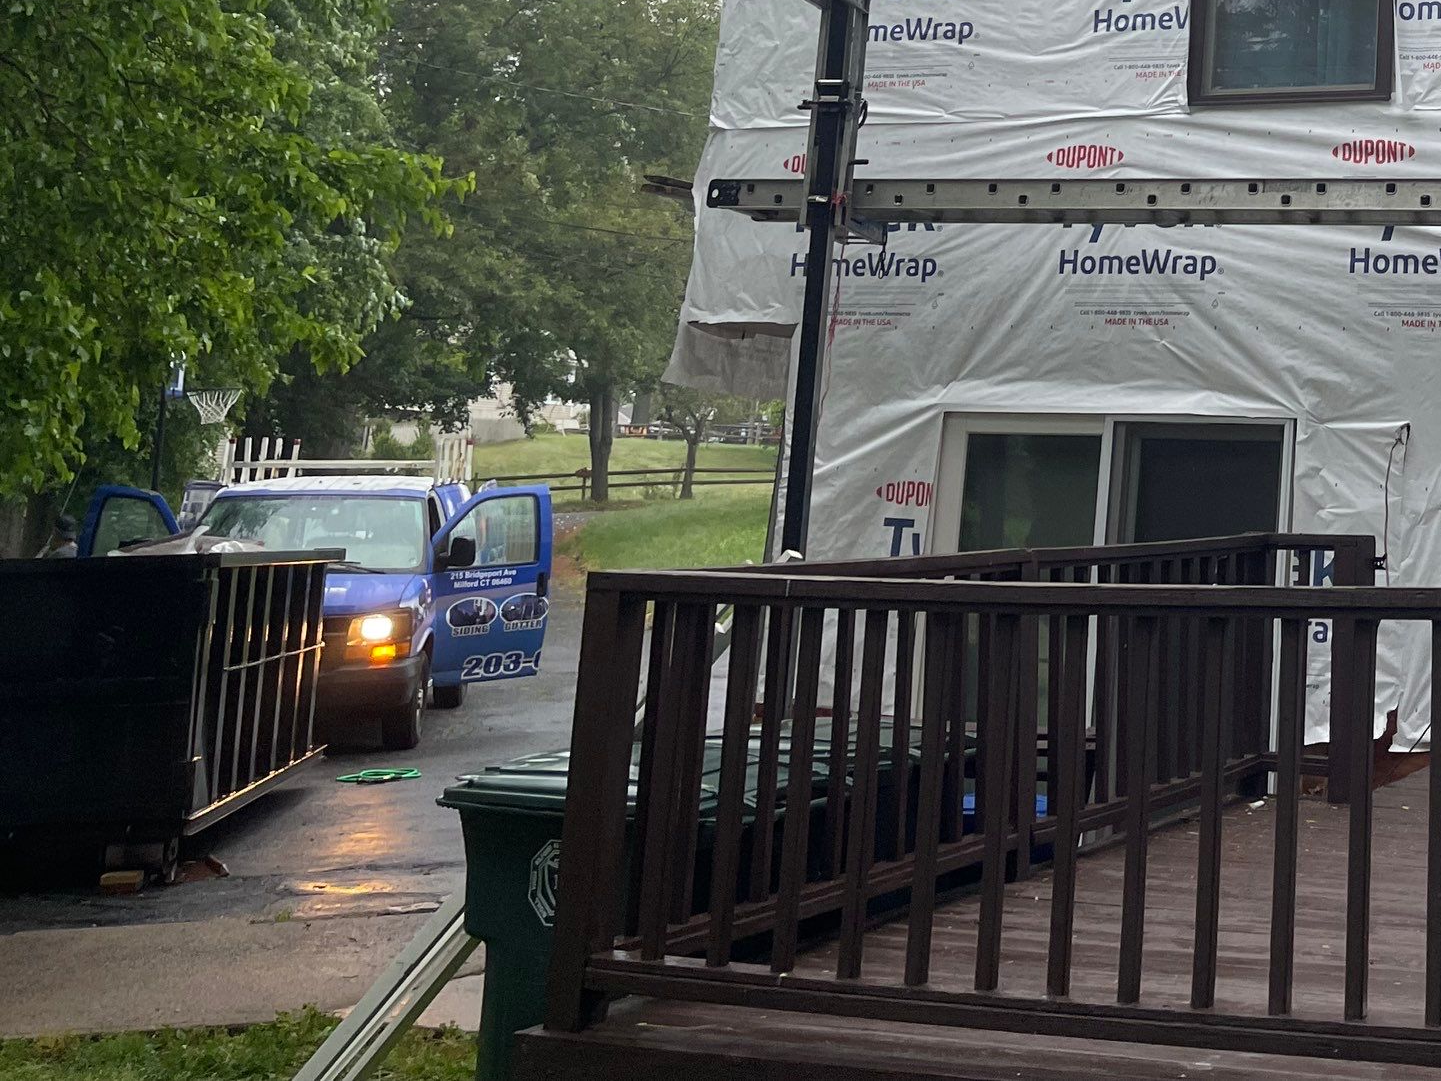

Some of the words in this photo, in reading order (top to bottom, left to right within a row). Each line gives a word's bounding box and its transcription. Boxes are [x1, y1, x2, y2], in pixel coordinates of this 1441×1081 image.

[867, 17, 974, 45] meWrap
[867, 81, 887, 89] MADE
[888, 80, 896, 88] IN
[912, 79, 926, 88] USA
[1056, 145, 1116, 168] DUPONT
[1342, 139, 1406, 164] DUPONT
[790, 252, 938, 283] HmeWrap
[1058, 249, 1218, 281] HomeWrap
[1104, 318, 1127, 326] MADE
[1128, 318, 1137, 326] IN
[1138, 318, 1152, 326] THE
[1153, 318, 1169, 326] USA
[1401, 320, 1426, 328] MADE
[1427, 320, 1437, 328] IN
[886, 481, 933, 507] DUPON
[450, 571, 463, 580] 215
[465, 569, 502, 580] Bridgeport
[503, 569, 517, 577] Ave
[452, 624, 490, 637] SIDING
